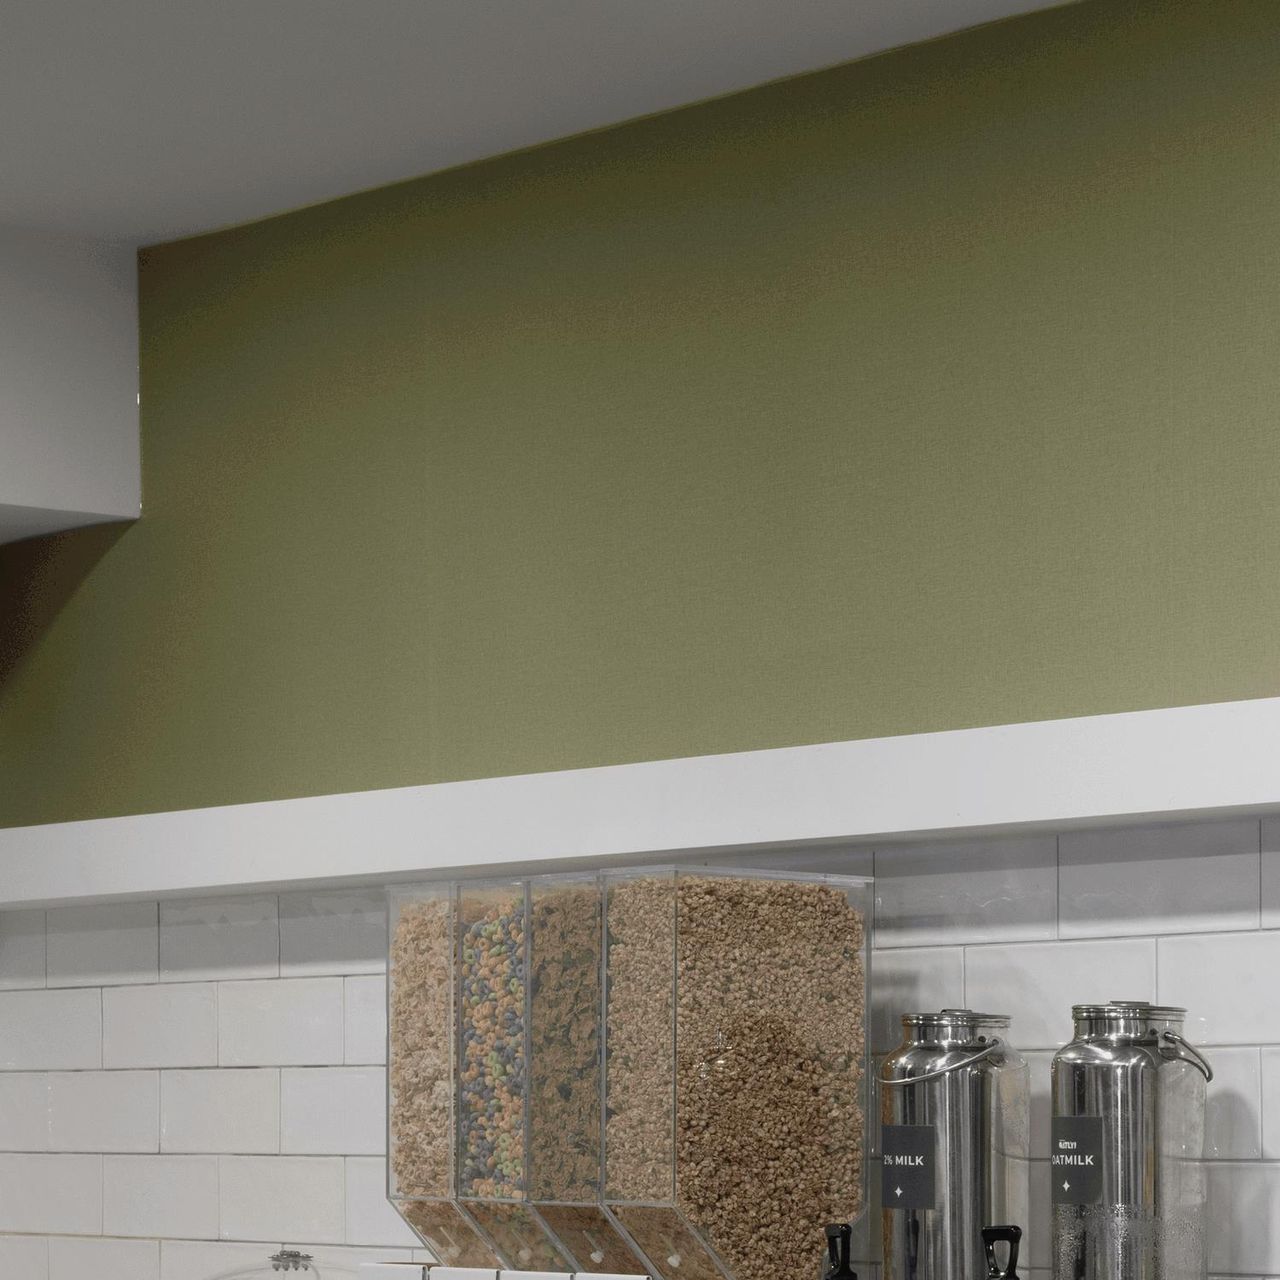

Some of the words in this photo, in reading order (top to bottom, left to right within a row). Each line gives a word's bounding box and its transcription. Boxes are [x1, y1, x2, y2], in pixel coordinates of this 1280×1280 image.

[884, 1155, 893, 1165] 2%
[895, 1155, 924, 1166] MILK
[1052, 1154, 1094, 1166] OATMILK
